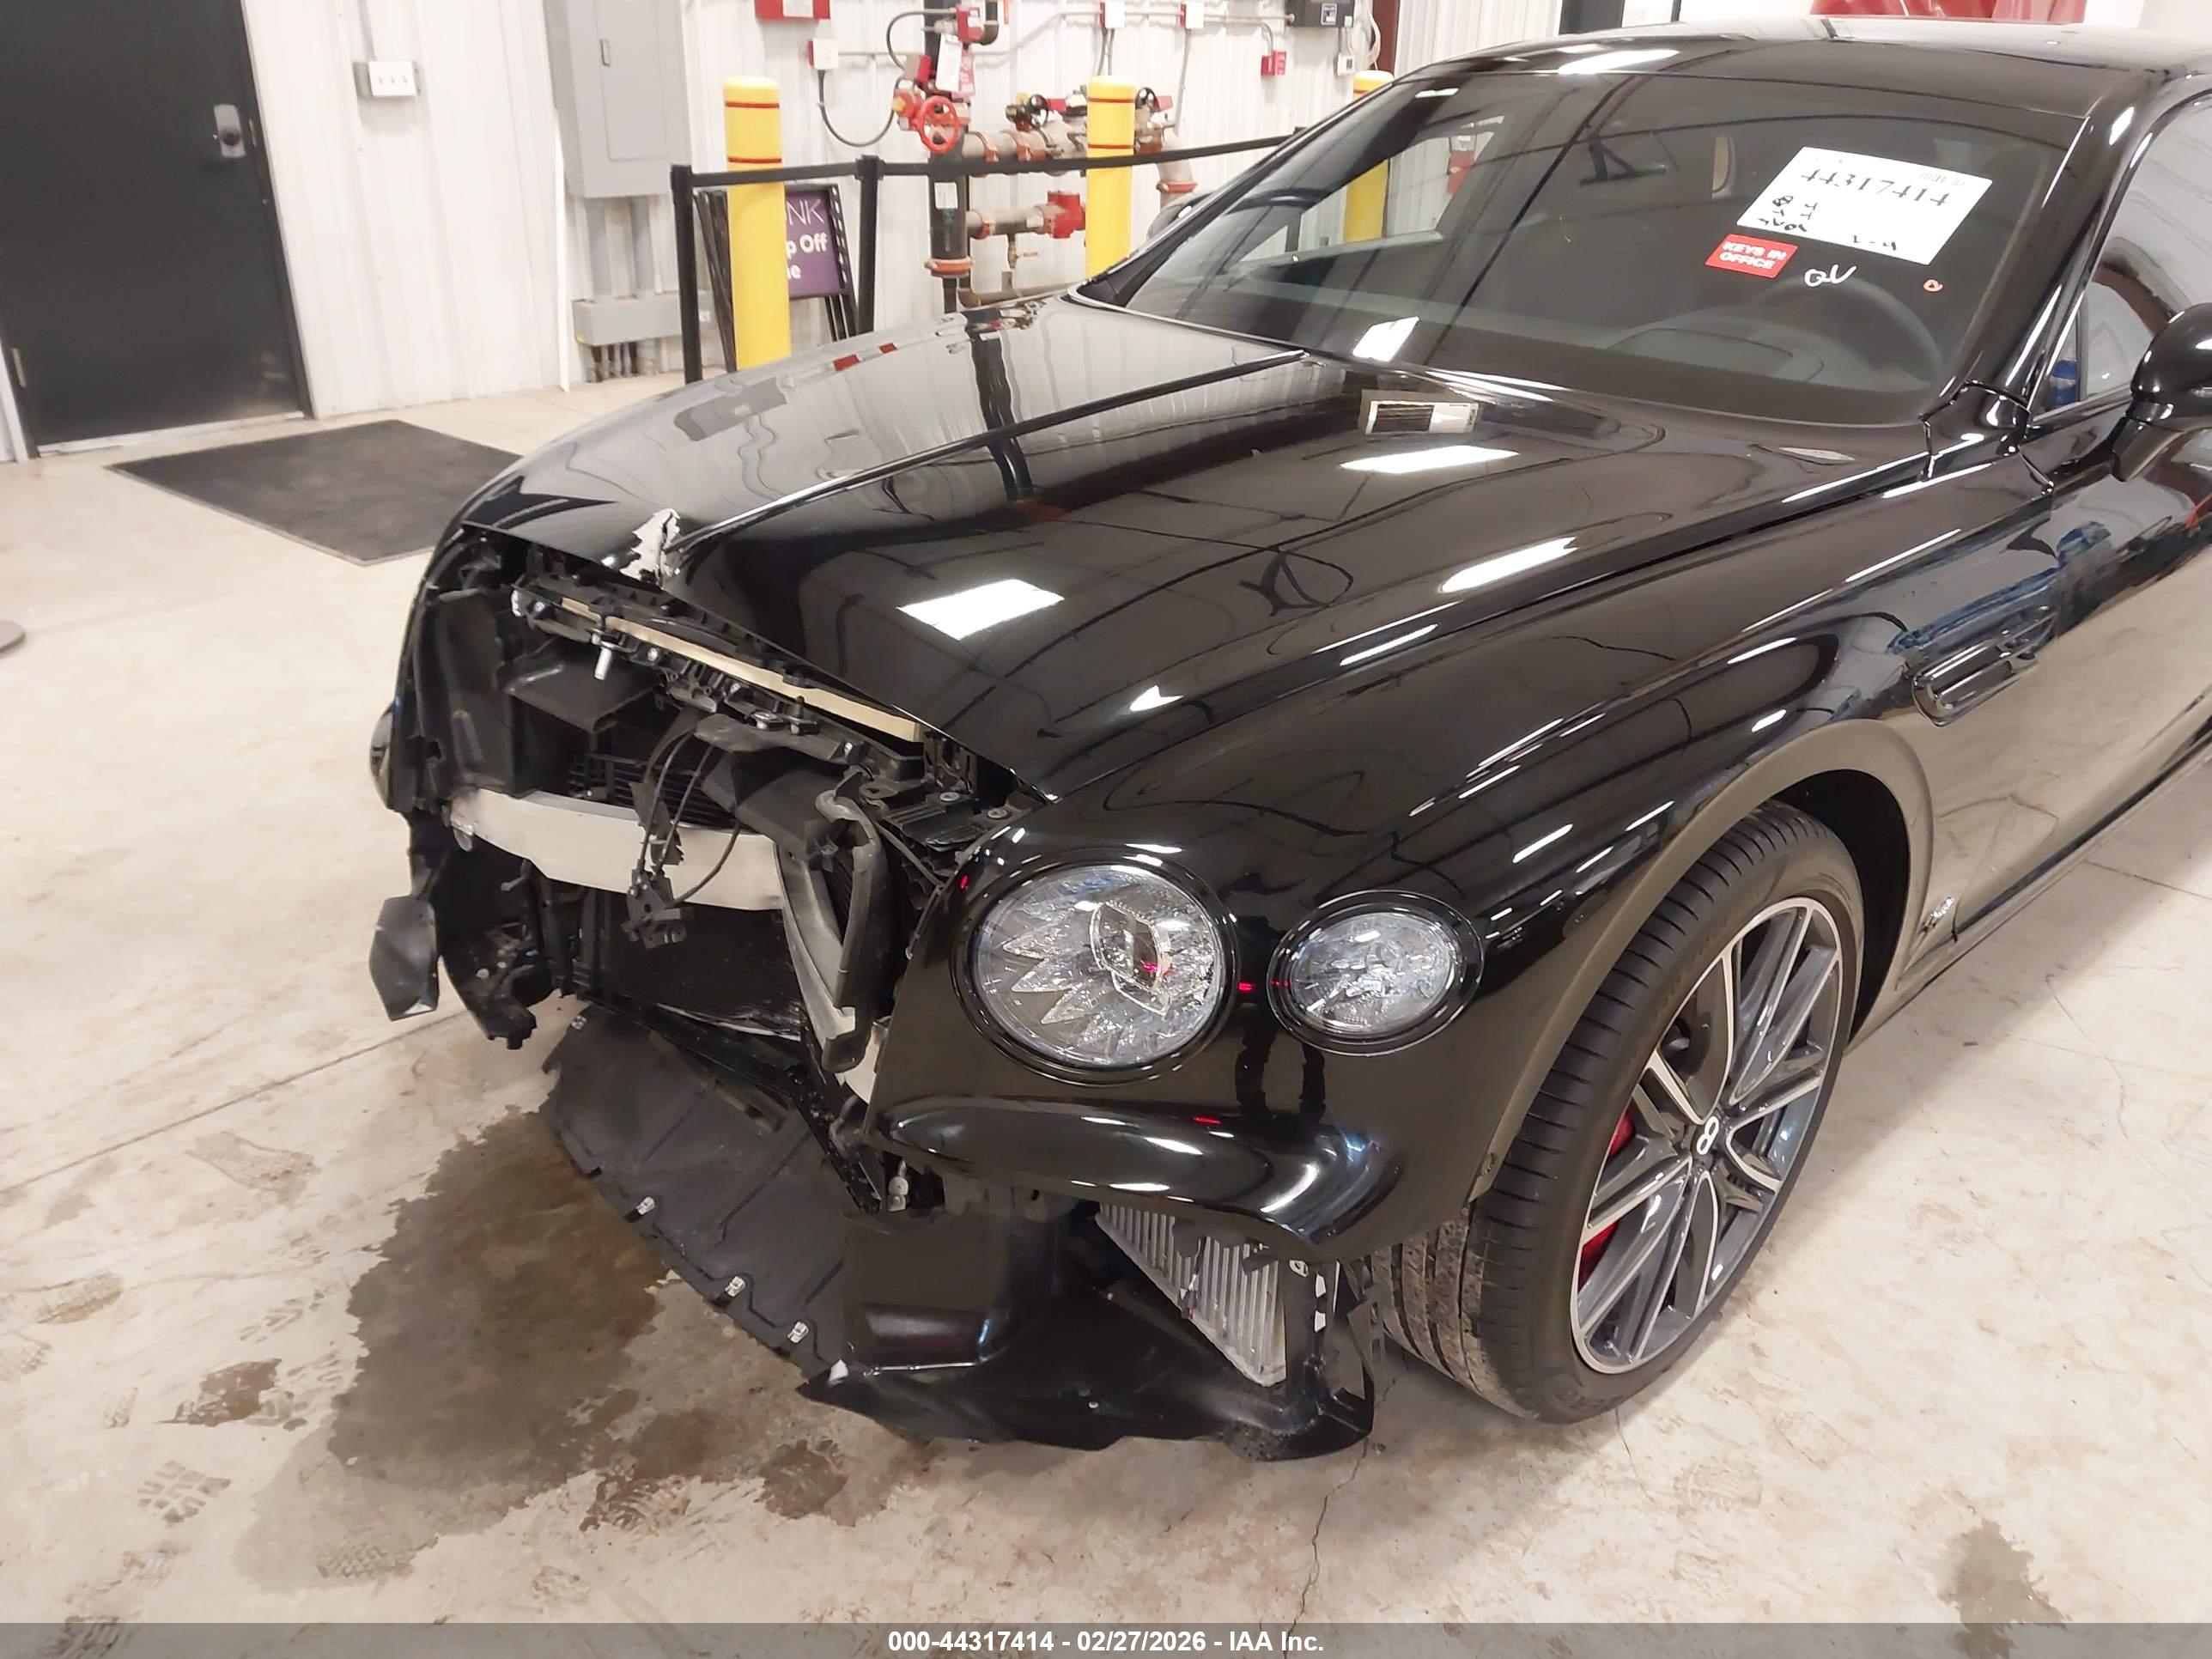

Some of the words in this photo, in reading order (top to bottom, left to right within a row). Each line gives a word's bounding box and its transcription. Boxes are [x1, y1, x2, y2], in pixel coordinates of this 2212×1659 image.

[1801, 168, 1950, 206] 44317414
[799, 232, 827, 252] Off
[1722, 240, 1765, 256] KEYS
[1766, 249, 1787, 261] IN
[1719, 252, 1777, 270] OFFICE
